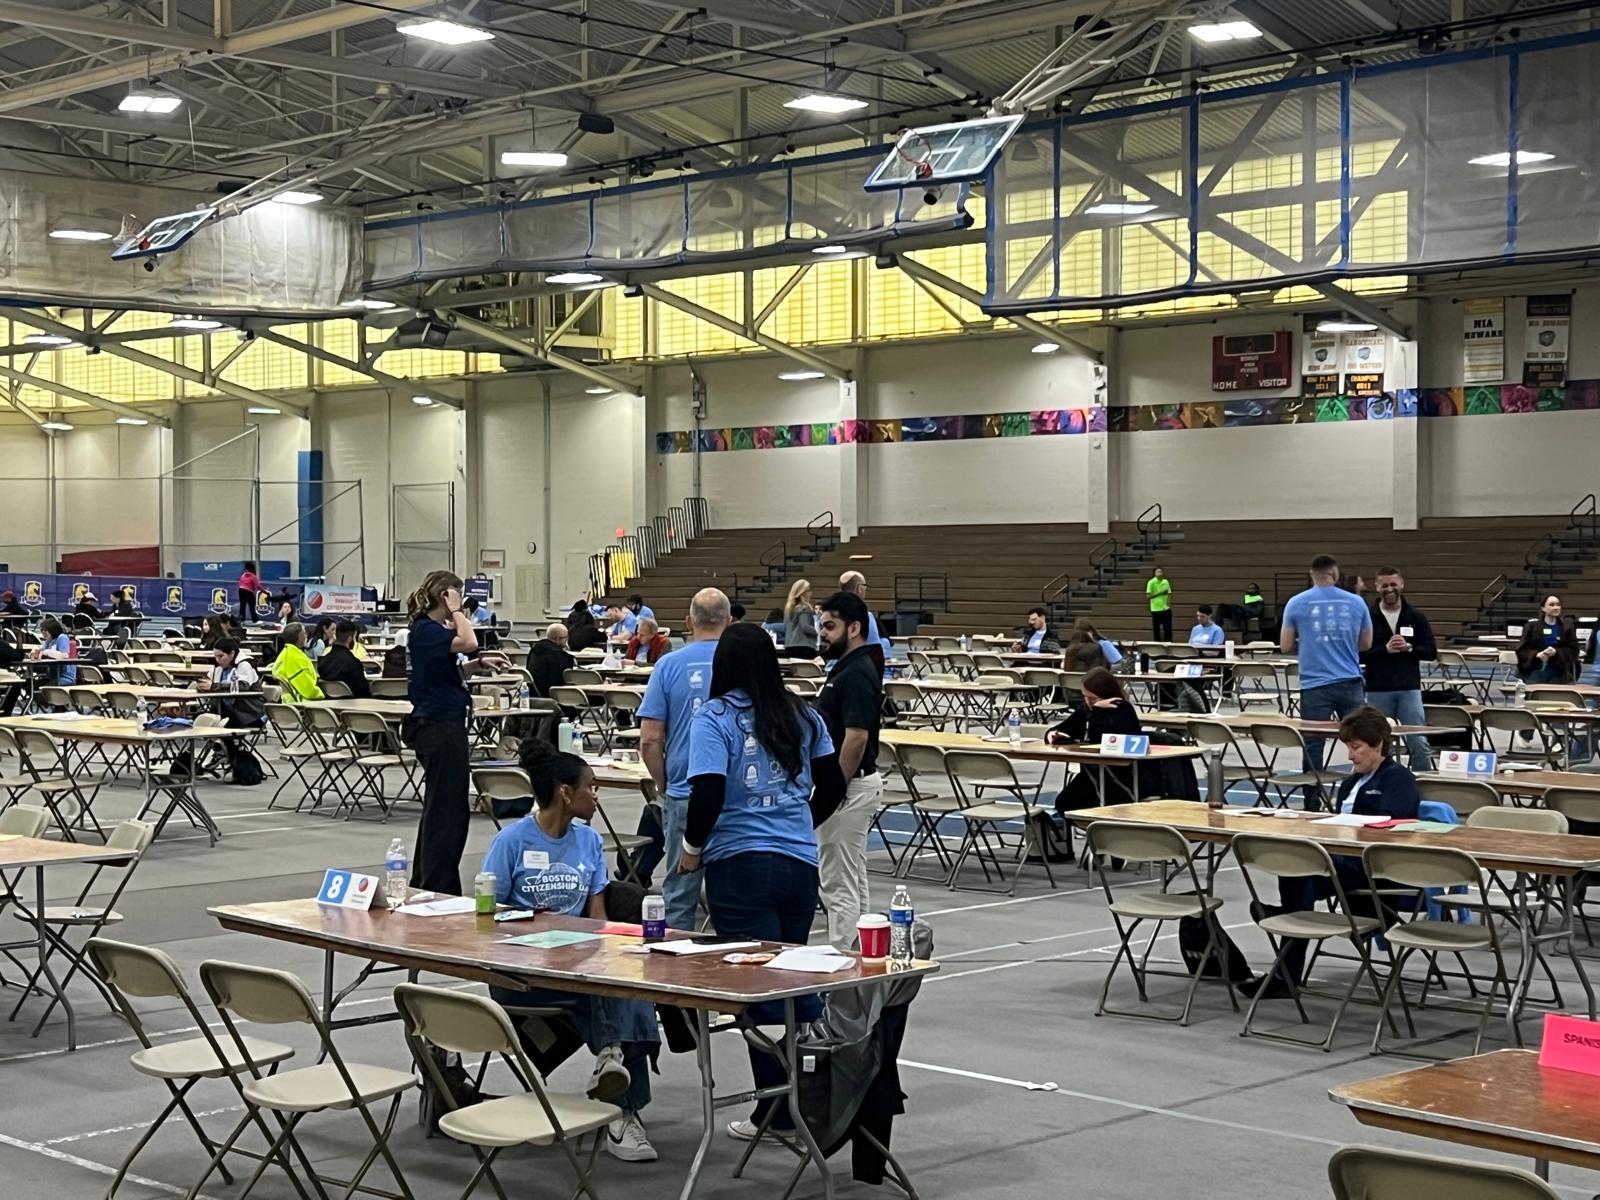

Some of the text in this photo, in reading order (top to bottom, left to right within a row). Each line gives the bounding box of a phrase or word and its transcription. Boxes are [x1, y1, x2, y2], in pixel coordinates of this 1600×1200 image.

[1473, 319, 1493, 328] NIA
[1213, 381, 1238, 390] HOME
[1259, 378, 1287, 387] VISITOR
[1129, 737, 1141, 752] 7
[1475, 754, 1488, 771] 6
[542, 874, 578, 883] BOSTON
[327, 875, 344, 899] 8
[521, 882, 577, 893] CITIZENSHIP
